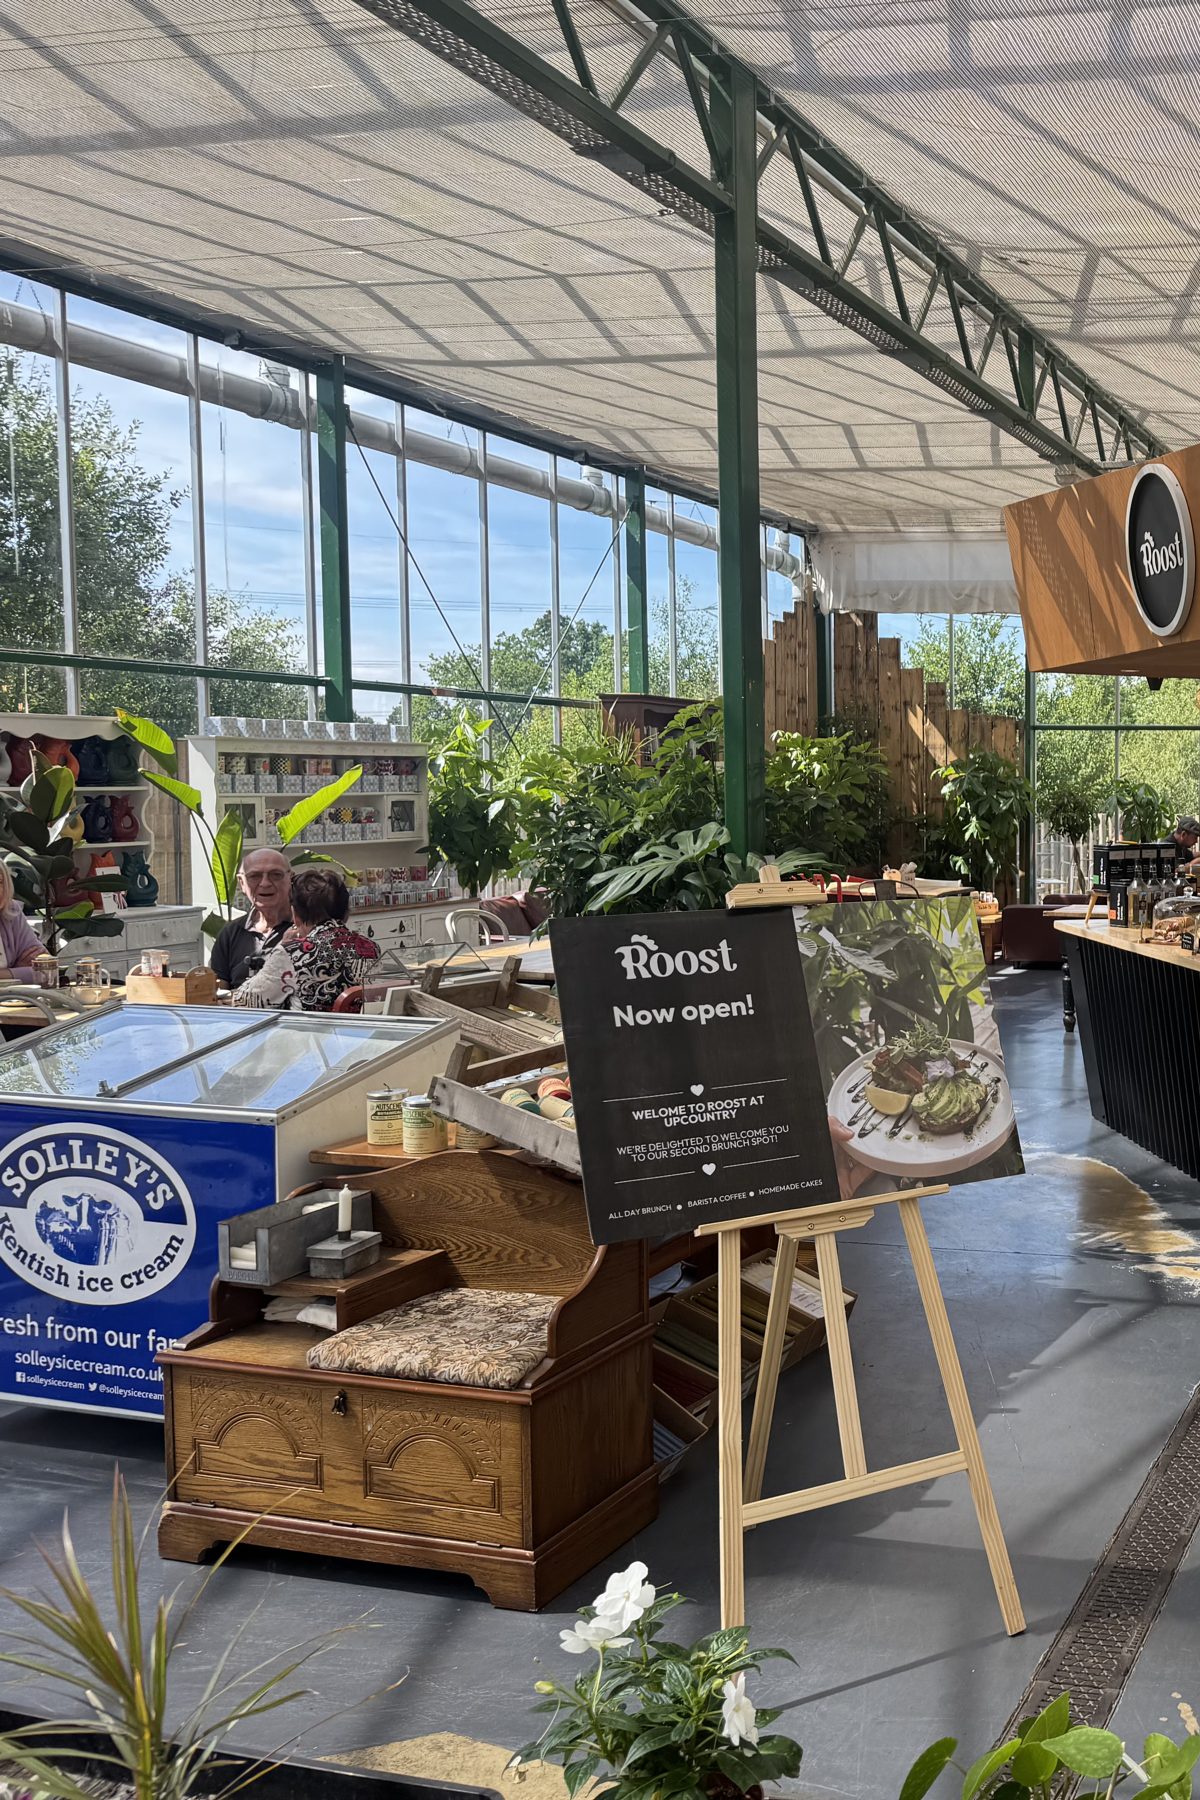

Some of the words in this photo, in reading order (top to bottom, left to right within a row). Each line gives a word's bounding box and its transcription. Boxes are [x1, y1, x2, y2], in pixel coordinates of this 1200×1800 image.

[1140, 532, 1184, 577] Roost
[614, 934, 738, 980] Roost
[613, 1004, 674, 1028] Now
[682, 994, 754, 1024] open!
[632, 1104, 686, 1120] WELOME
[688, 1102, 706, 1114] TO
[708, 1097, 747, 1111] ROOST
[750, 1095, 765, 1106] AT
[664, 1109, 738, 1127] UPCOUNTRY
[617, 1144, 646, 1155] WE'RE
[649, 1137, 703, 1152] DELIGHTED
[705, 1134, 719, 1144] TO
[720, 1128, 767, 1142] WELCOME
[769, 1125, 789, 1135] YOU
[631, 1153, 645, 1162] TO
[647, 1150, 668, 1160] OUR
[670, 1144, 709, 1158] SECOND
[712, 1139, 749, 1152] BRUNCH
[751, 1134, 778, 1146] SPOT!
[2, 1140, 174, 1210] SOLLEY'S
[758, 1183, 800, 1195] HOMEMADE
[800, 1179, 823, 1189] CAKES
[608, 1212, 623, 1220] ALL
[642, 1204, 672, 1215] BRUNCH
[688, 1197, 718, 1208] BARISTA
[719, 1192, 747, 1203] COFFEE
[0, 1212, 70, 1288] Kentish
[78, 1270, 114, 1292] ice
[120, 1234, 184, 1289] cream
[46, 1316, 98, 1344] from
[104, 1330, 141, 1350] our
[147, 1329, 177, 1352] far
[15, 1350, 164, 1382] solleysicecream.co.uk
[26, 1375, 84, 1389] solleysicecream
